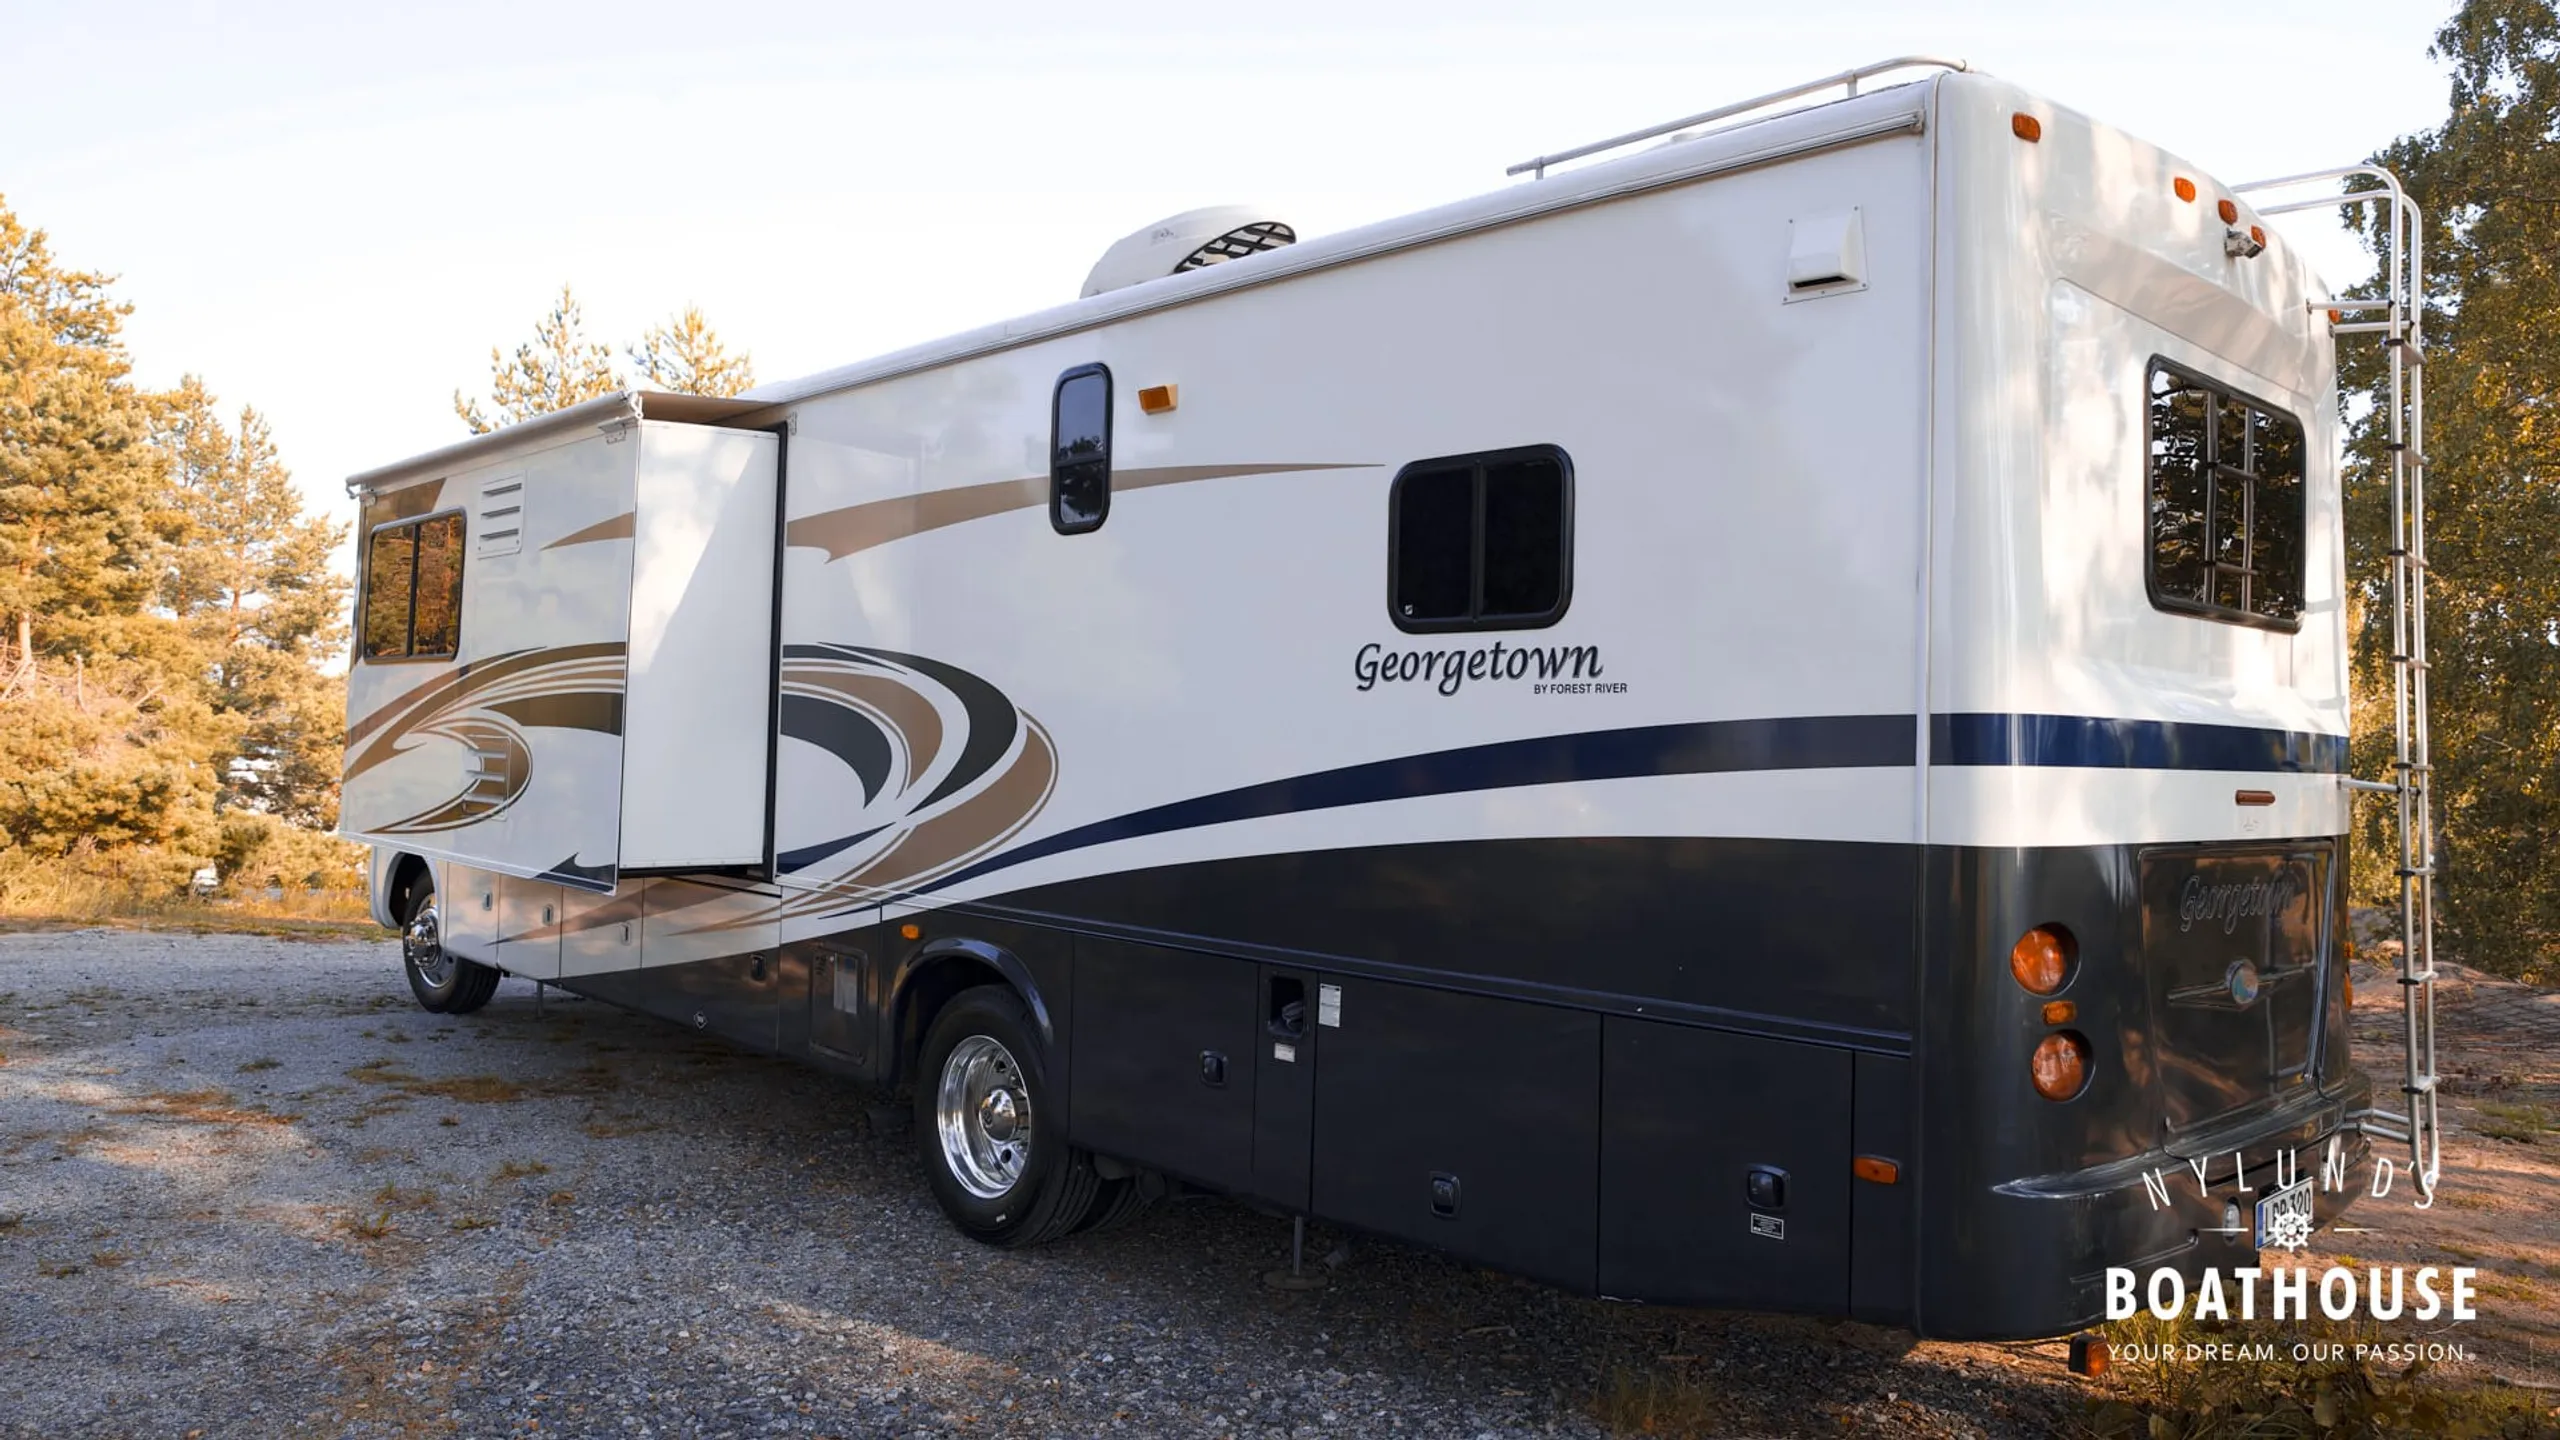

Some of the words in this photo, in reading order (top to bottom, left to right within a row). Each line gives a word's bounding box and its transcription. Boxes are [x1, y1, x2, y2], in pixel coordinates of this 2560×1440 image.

[1355, 641, 1604, 697] Georgetown
[1534, 684, 1548, 695] BY
[1550, 683, 1592, 694] FOREST
[1595, 683, 1628, 694] RIVER
[2180, 874, 2296, 935] Georgetown
